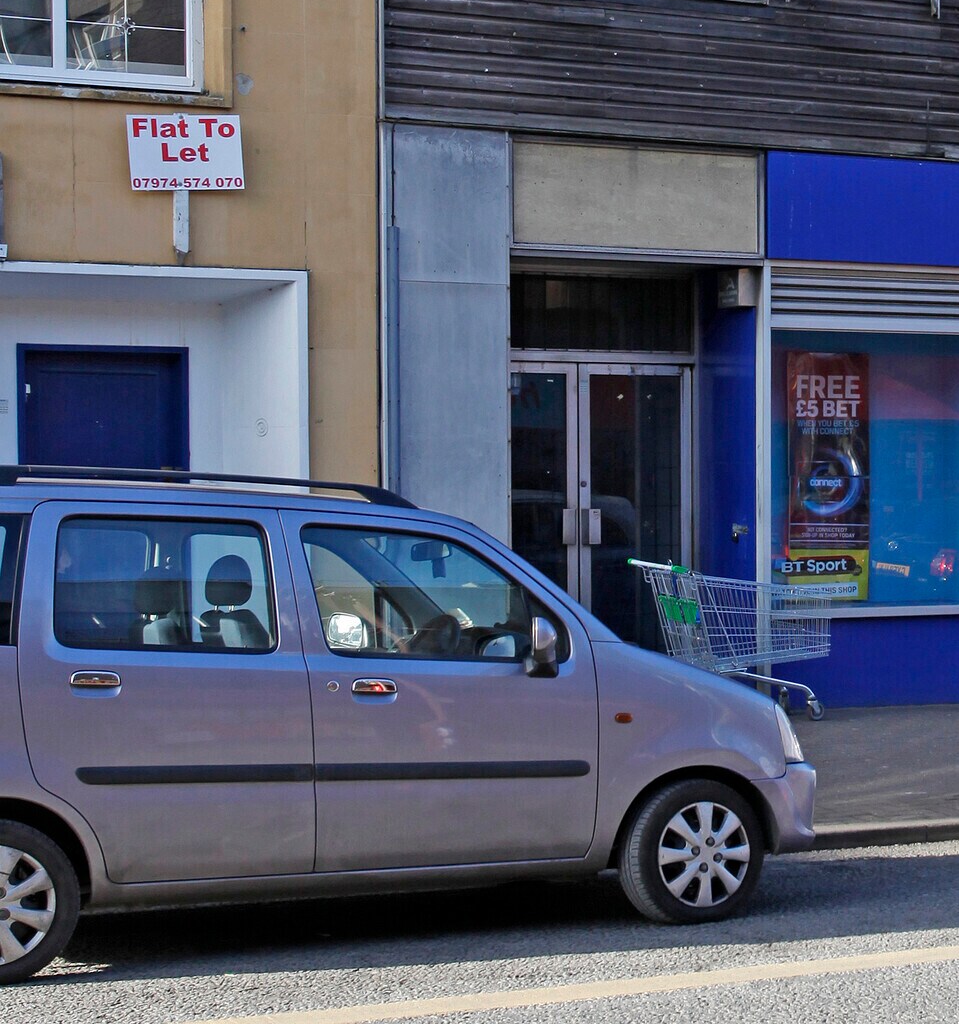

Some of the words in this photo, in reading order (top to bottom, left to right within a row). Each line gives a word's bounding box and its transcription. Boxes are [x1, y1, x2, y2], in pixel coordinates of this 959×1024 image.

[132, 118, 189, 138] Flat
[199, 119, 235, 138] To
[161, 143, 209, 162] Let
[133, 178, 178, 189] 07974
[184, 178, 211, 188] 574
[216, 177, 243, 188] 070
[796, 375, 860, 399] FREE
[796, 400, 819, 418] £5
[823, 400, 860, 418] BET
[810, 479, 842, 487] connect
[781, 562, 804, 573] BT
[807, 559, 847, 574] Sport
